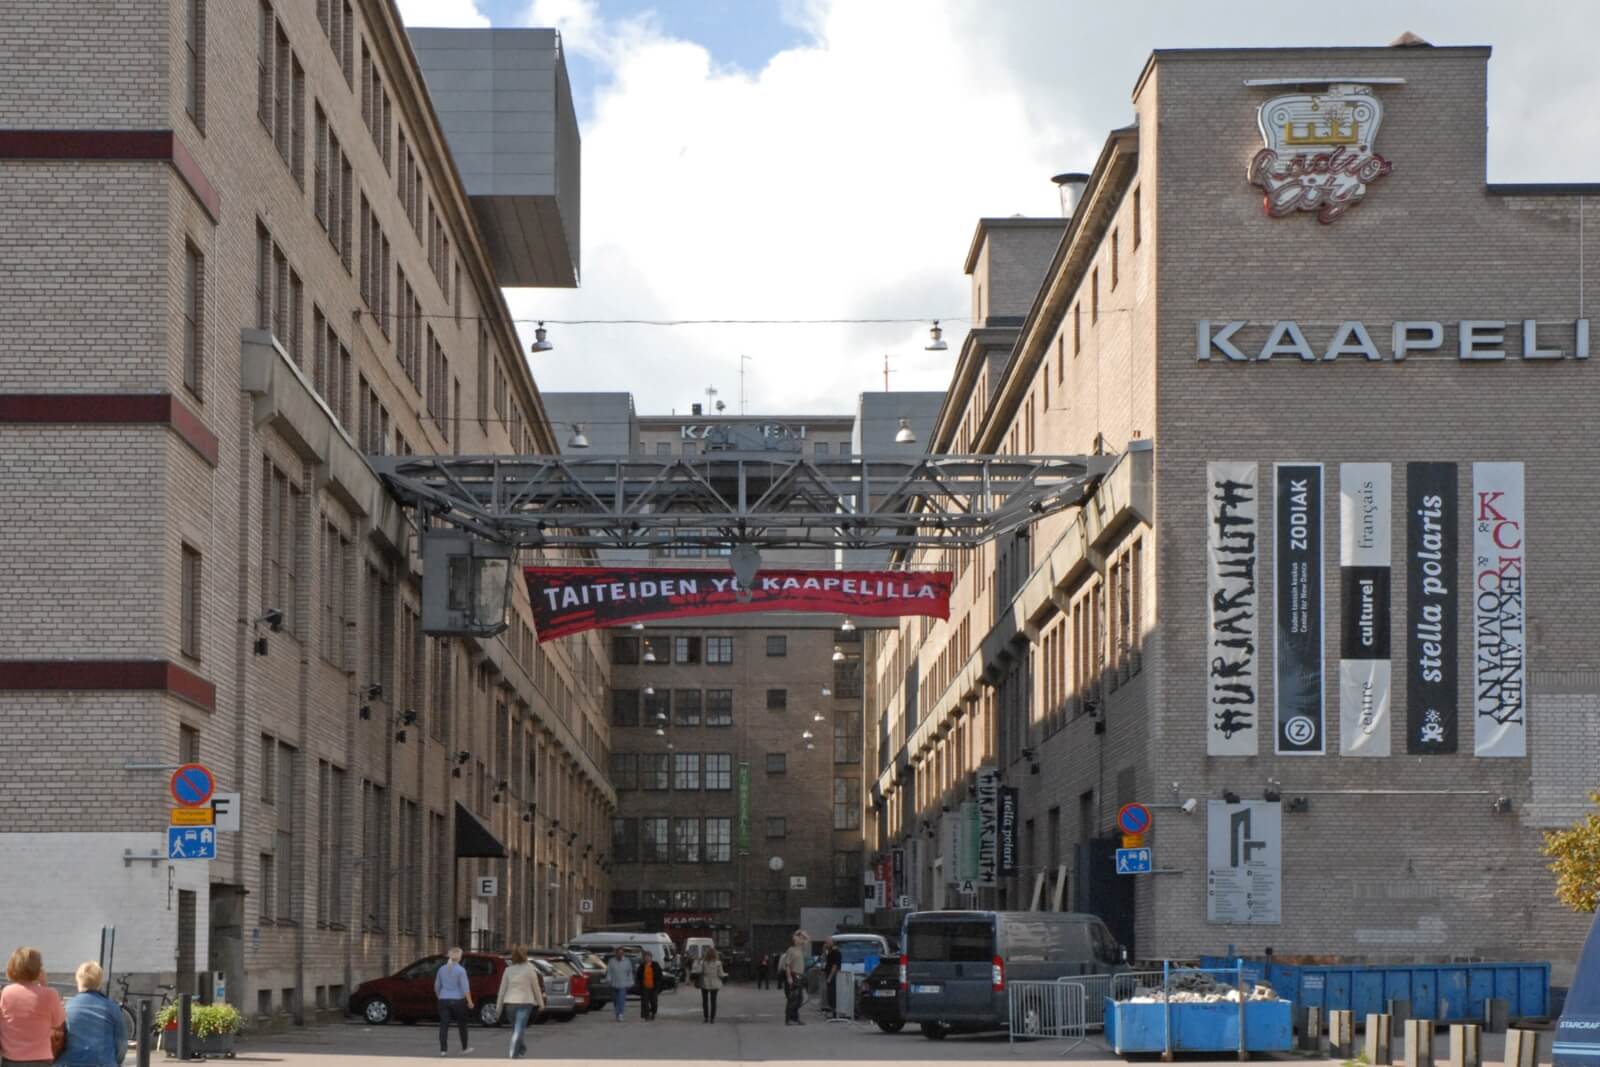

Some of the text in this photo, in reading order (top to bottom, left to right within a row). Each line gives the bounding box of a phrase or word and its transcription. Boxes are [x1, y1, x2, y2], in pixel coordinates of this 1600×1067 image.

[1197, 318, 1591, 361] KAAPELI
[1290, 479, 1308, 551] ZODIAK
[1358, 480, 1378, 549] français
[1478, 491, 1506, 522] K
[1493, 521, 1521, 550] C
[544, 579, 697, 612] TAITEIDEN
[763, 576, 935, 600] KAAPELILLA
[1359, 579, 1374, 646] culturel
[1418, 494, 1447, 683] stella polaris
[1478, 569, 1505, 726] COMPANY
[1498, 556, 1523, 726] KEKÄLÄINEN
[1358, 681, 1374, 737] centre
[211, 799, 230, 825] F
[1002, 794, 1014, 870] stella polaris
[482, 880, 493, 894] E
[963, 881, 975, 893] A
